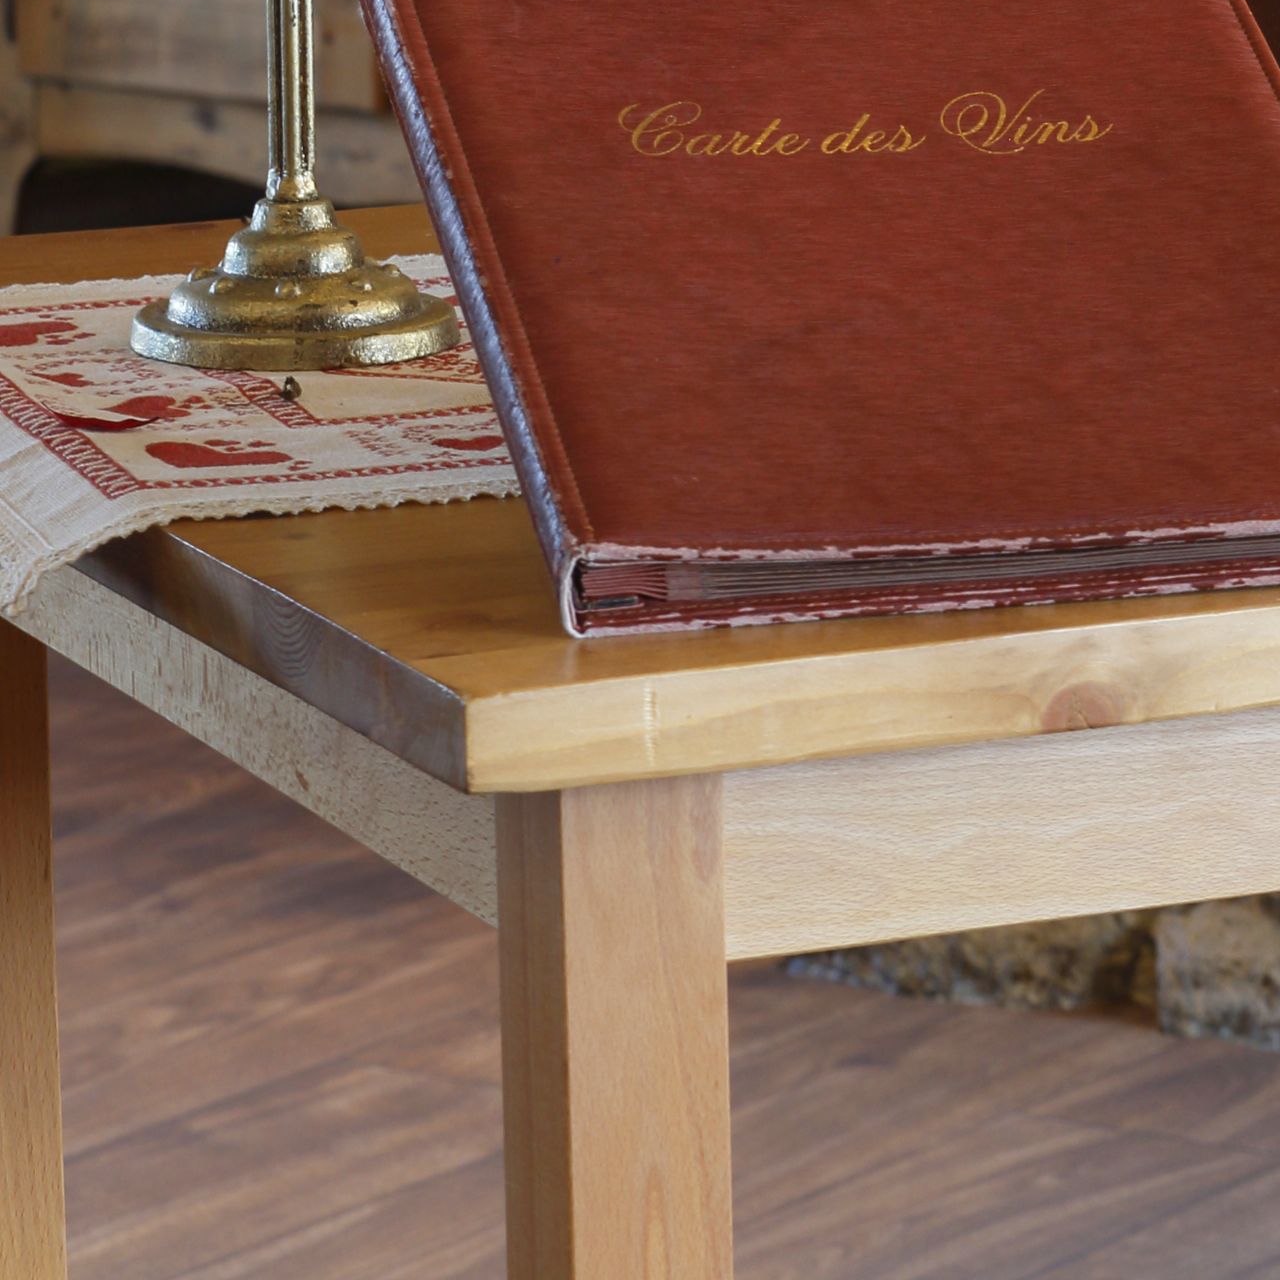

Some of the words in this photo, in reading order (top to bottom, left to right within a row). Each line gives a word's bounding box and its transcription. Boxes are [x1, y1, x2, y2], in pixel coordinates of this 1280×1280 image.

[617, 100, 810, 157] Carte
[820, 112, 927, 155] des
[939, 87, 1115, 156] Vins
